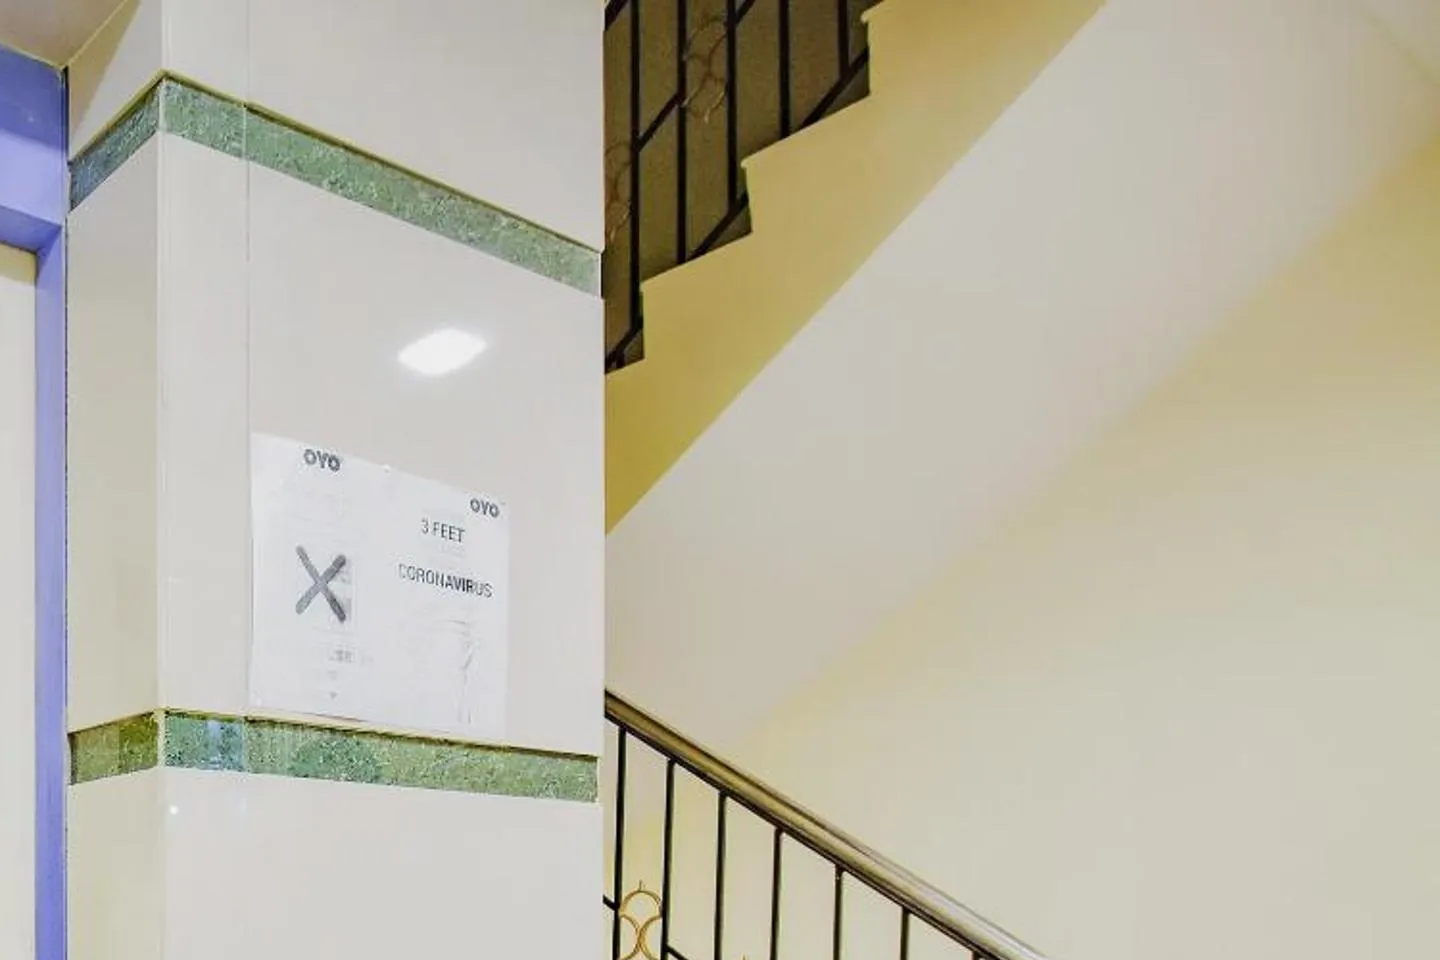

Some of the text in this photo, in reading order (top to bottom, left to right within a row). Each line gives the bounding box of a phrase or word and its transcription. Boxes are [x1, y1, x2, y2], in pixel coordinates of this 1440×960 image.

[303, 449, 341, 472] OYO
[470, 497, 500, 518] OYO
[421, 517, 466, 543] 3 FEET
[398, 563, 493, 599] CORONAVIRUS
